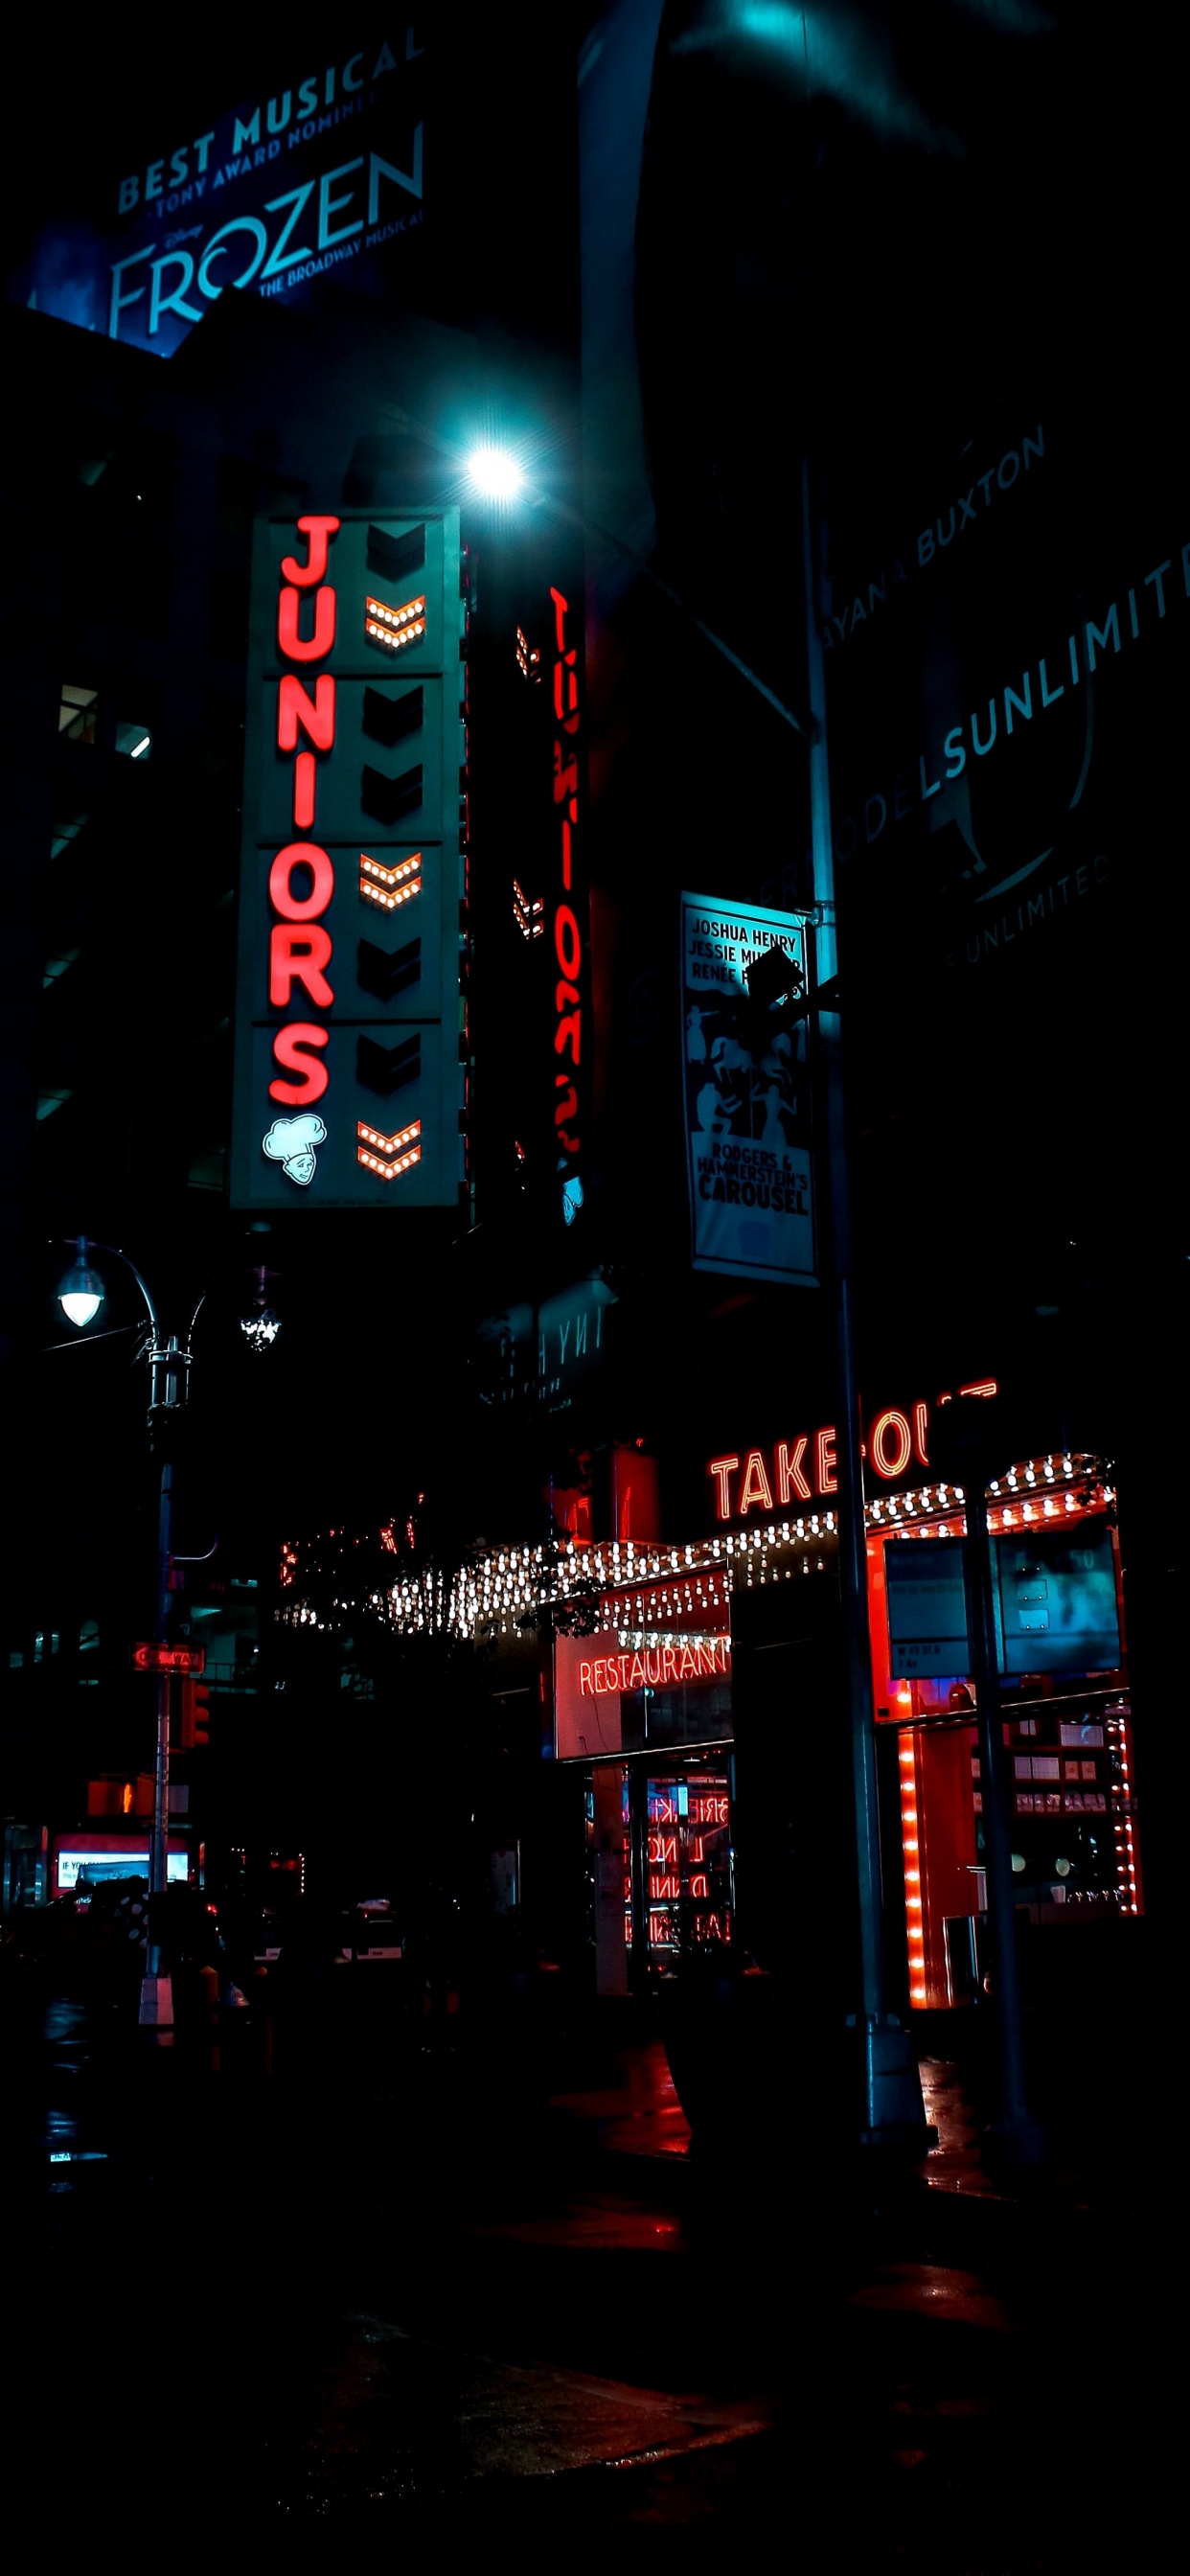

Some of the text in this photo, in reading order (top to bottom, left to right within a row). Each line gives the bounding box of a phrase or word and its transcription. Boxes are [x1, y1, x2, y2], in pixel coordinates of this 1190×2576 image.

[117, 25, 426, 216] BEST MUSICAL
[155, 177, 207, 219] TONY
[213, 138, 282, 191] AWARD
[108, 119, 423, 340] FROZEN
[259, 275, 285, 298] THE
[287, 242, 362, 285] BROADWAY
[917, 422, 1045, 567] BUXTON
[268, 515, 340, 1106] JUNIORS
[689, 940, 737, 962] JESSIE
[692, 918, 796, 953] JOSHUA HENRY
[693, 962, 737, 983] RENÉE
[697, 1157, 808, 1190] HAMMERSTEIN'S
[712, 1141, 792, 1171] RODGERS &
[698, 1174, 809, 1216] CAROUSEL
[173, 1651, 198, 1666] WAY
[580, 1635, 731, 1696] RESTAURANT
